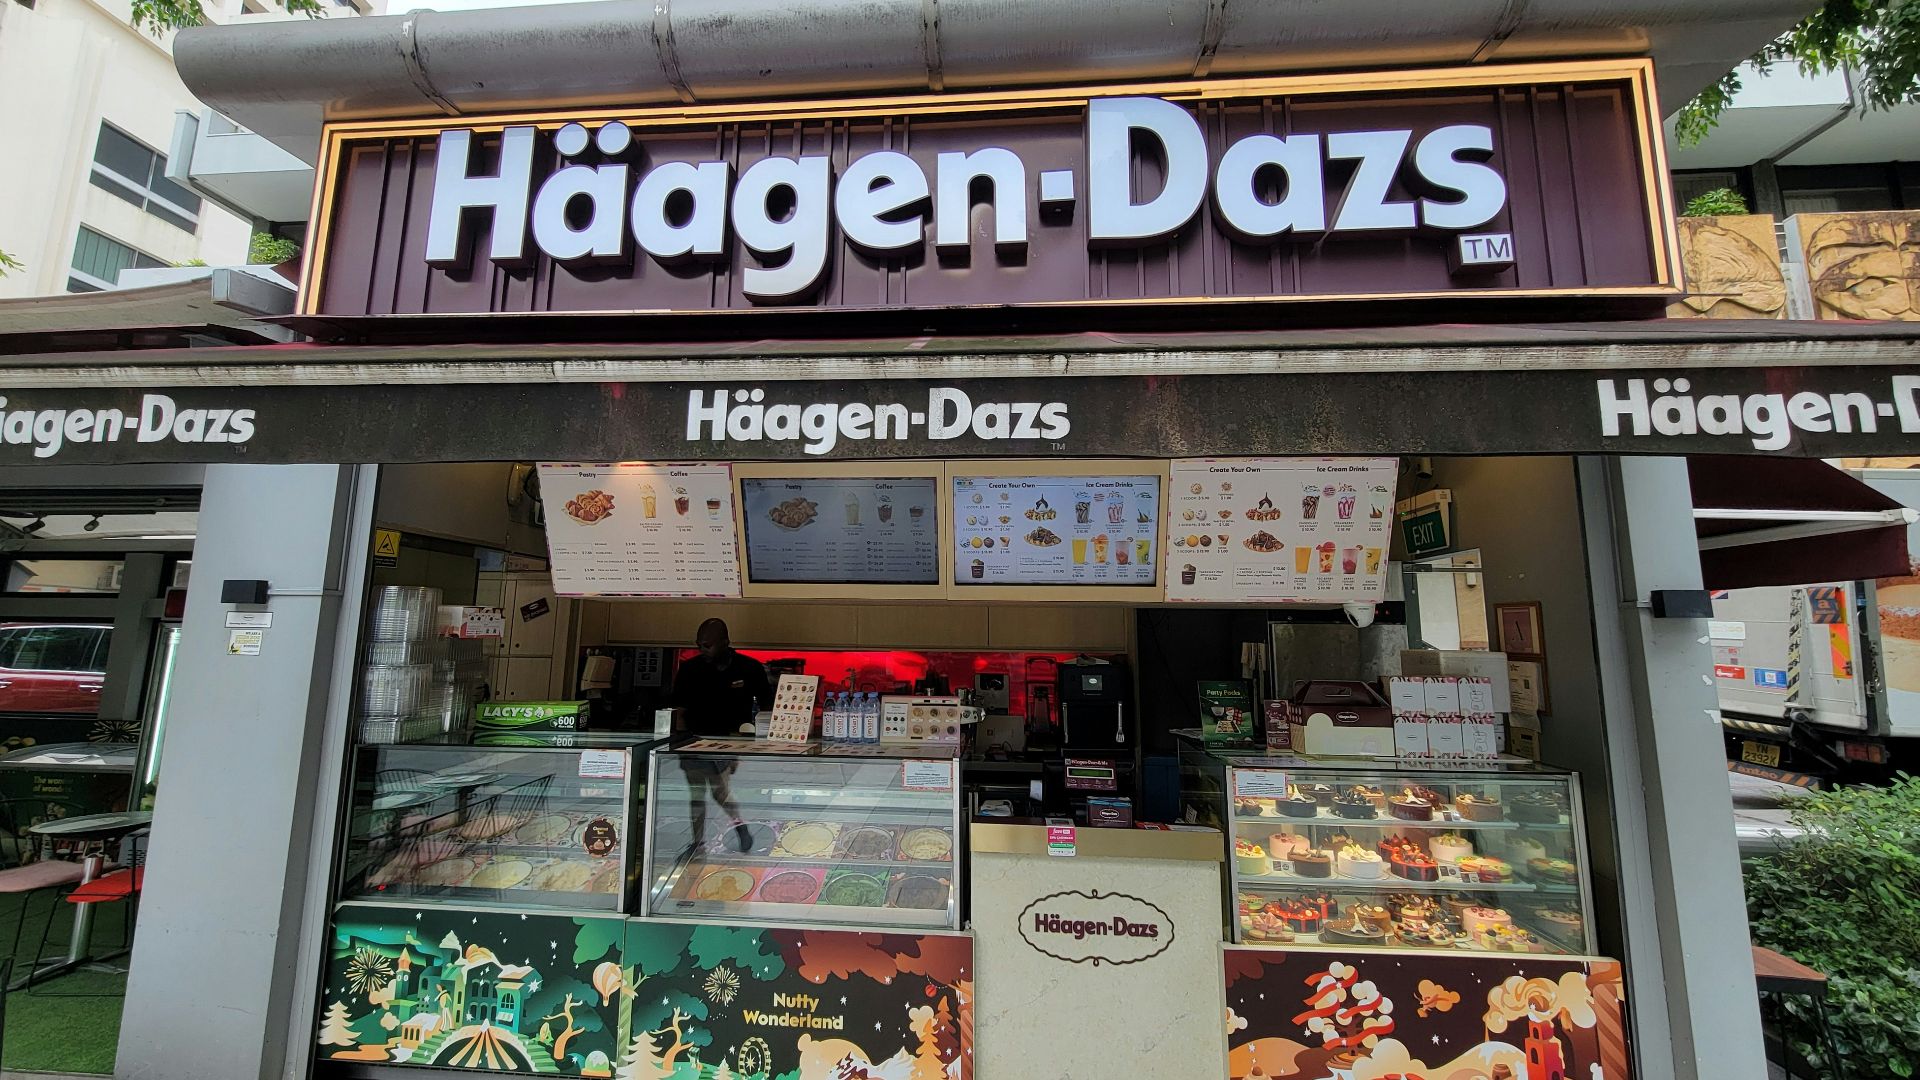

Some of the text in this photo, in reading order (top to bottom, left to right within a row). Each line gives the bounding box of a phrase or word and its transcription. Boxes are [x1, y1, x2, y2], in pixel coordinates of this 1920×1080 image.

[424, 96, 1507, 300] Häagen-Dazs
[1464, 237, 1510, 260] TM
[686, 387, 1071, 455] Häagen-Dazs
[1412, 521, 1435, 546] EXIT
[483, 706, 533, 718] LACY'S
[558, 716, 575, 725] 600
[1743, 751, 1777, 766] 2392K
[1755, 743, 1768, 754] YN
[1034, 912, 1159, 940] Häagen-Dazs
[773, 992, 820, 1013] Nutty
[742, 1009, 844, 1030] Wonderland
